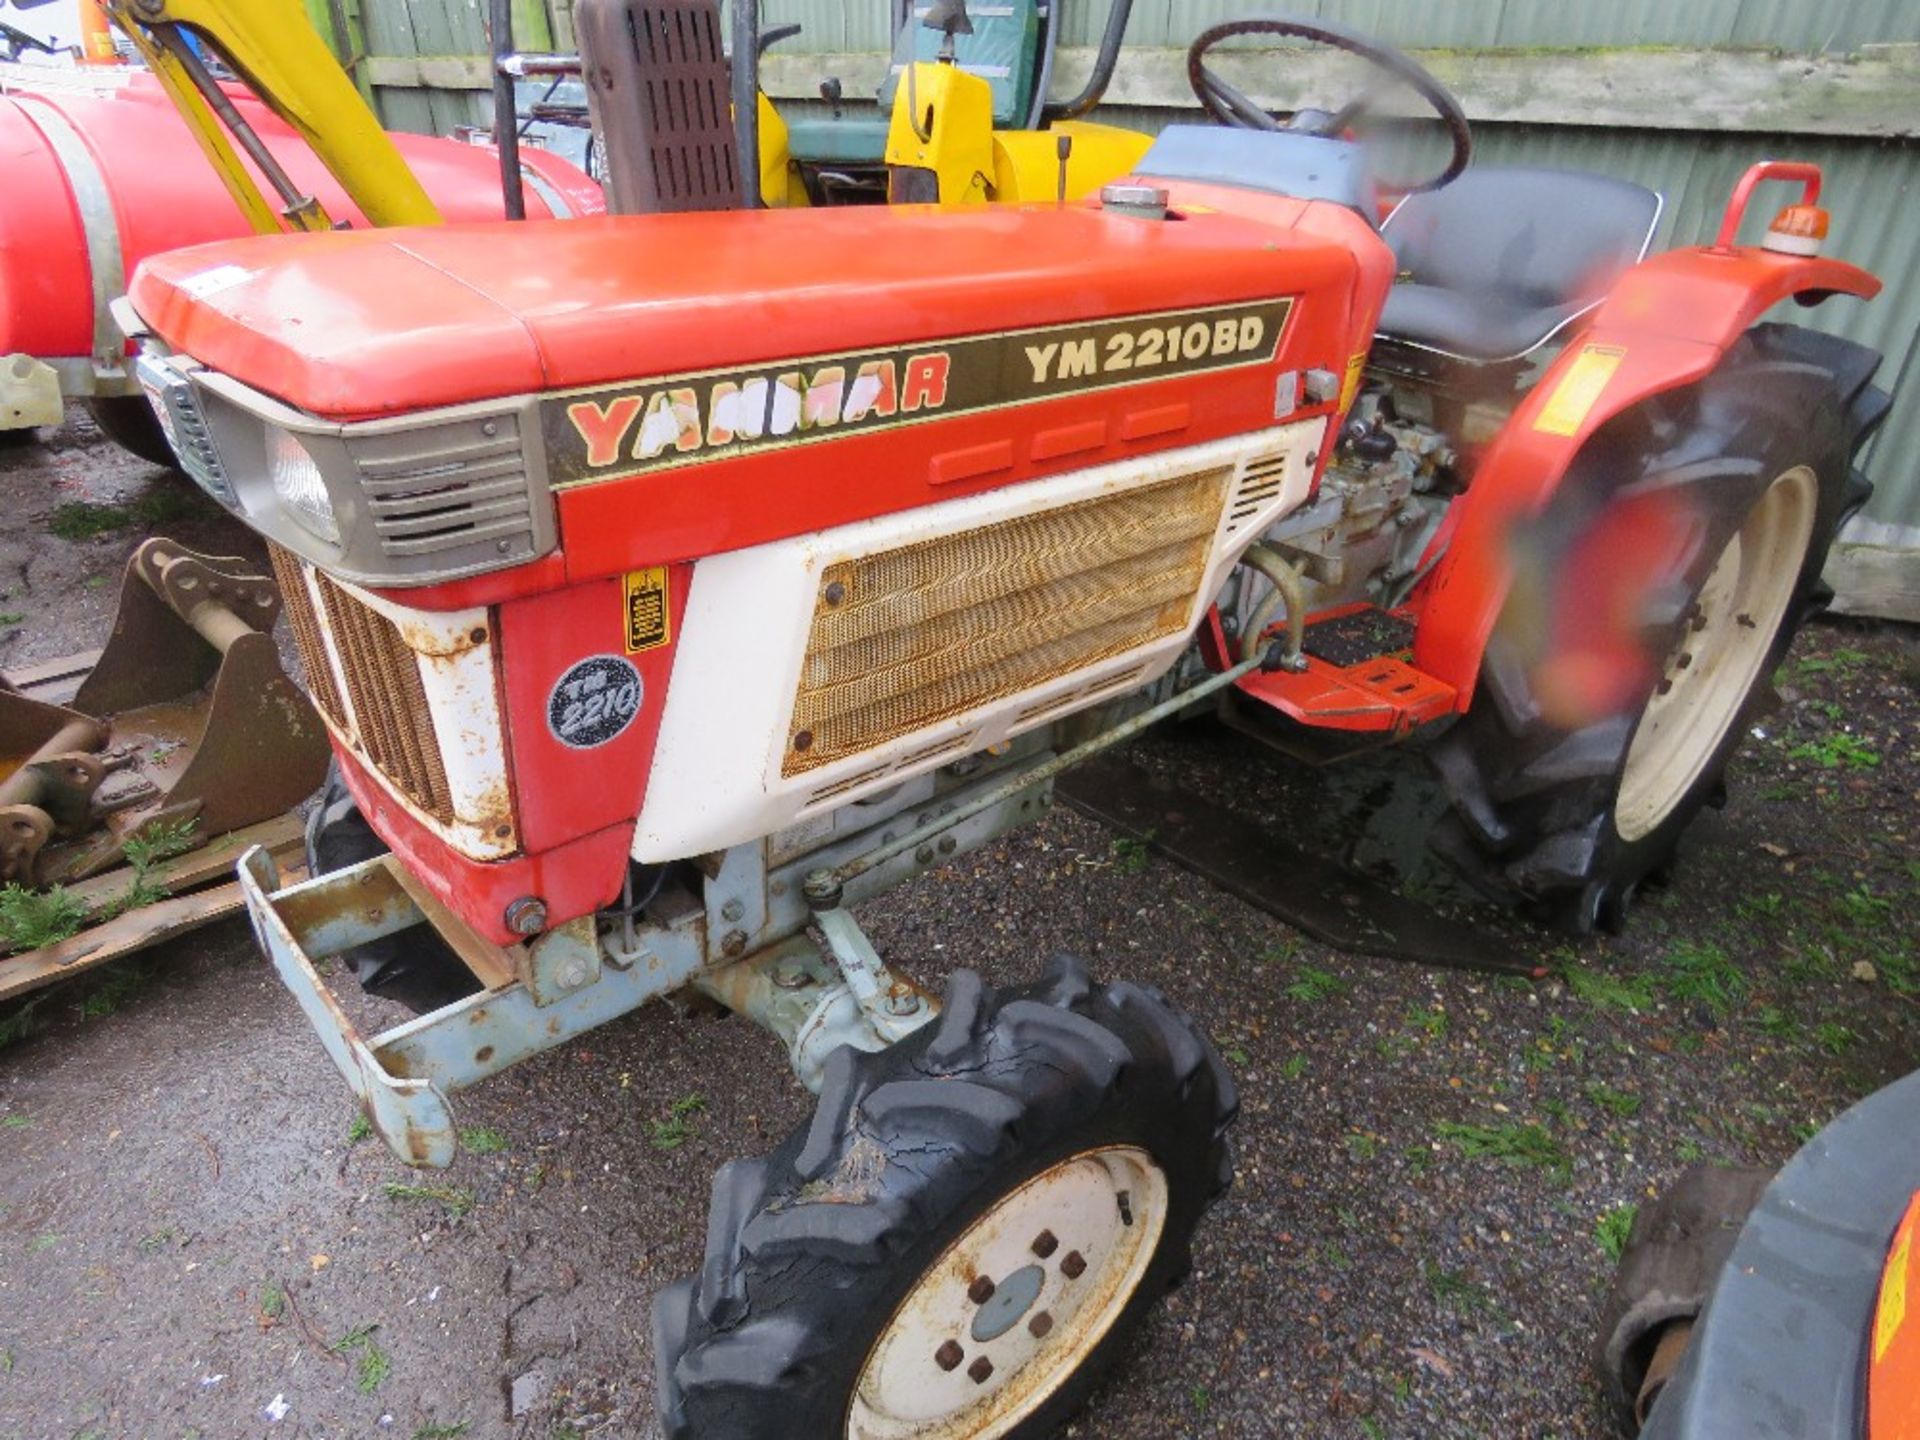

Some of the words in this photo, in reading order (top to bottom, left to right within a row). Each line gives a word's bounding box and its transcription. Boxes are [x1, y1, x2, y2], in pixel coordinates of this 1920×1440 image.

[567, 352, 951, 468] YANMAR
[1025, 337, 1097, 383] YM
[1104, 316, 1264, 371] 2210BD
[560, 681, 637, 736] 2210
